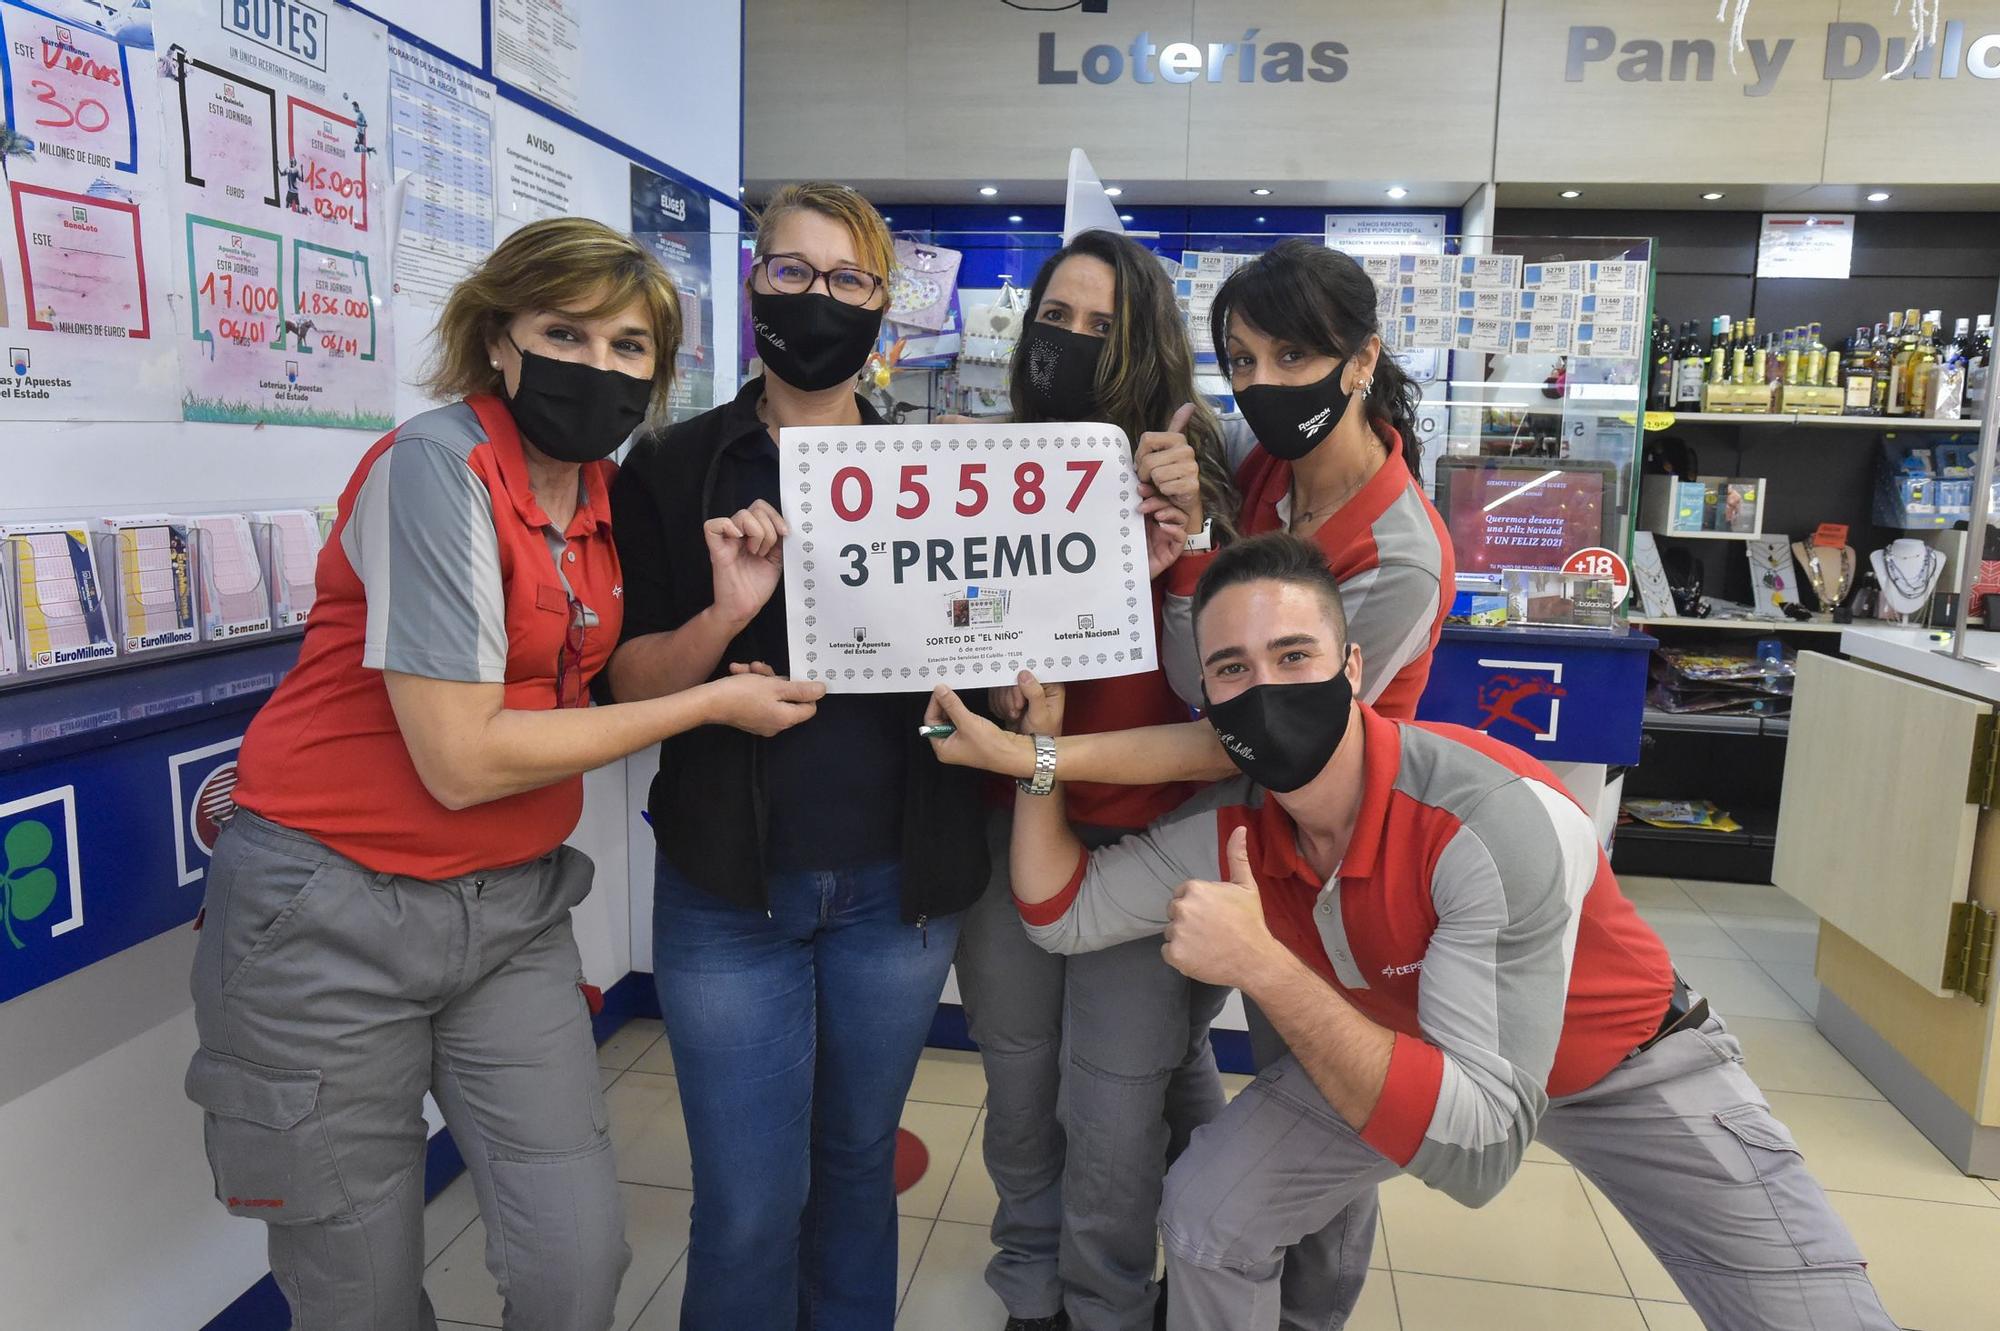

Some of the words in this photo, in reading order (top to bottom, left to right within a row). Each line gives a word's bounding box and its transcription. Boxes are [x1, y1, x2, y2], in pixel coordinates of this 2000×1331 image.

[14, 42, 35, 59] ESTE
[41, 36, 90, 58] EuroMillones
[229, 46, 239, 58] UN
[258, 58, 289, 80] ACERTANTE
[1037, 28, 1349, 85] Loterías
[1564, 25, 1716, 82] Pan
[1744, 38, 1795, 97] y
[31, 80, 110, 132] 30
[208, 103, 224, 116] ESTA
[225, 107, 253, 127] JORNADA
[311, 138, 324, 151] ESTA
[324, 143, 346, 159] JORNADA
[526, 133, 554, 155] AVISO
[39, 142, 74, 161] MILLONES
[76, 149, 86, 162] DE
[87, 152, 111, 169] EUROS
[226, 185, 245, 199] EUROS
[63, 220, 98, 233] BonoLoto
[32, 233, 52, 247] ESTE
[217, 259, 232, 272] ESTA
[233, 262, 259, 277] JORNADA
[199, 272, 279, 314] 17.000
[315, 279, 329, 292] ESTA
[298, 292, 369, 318] 1.856.000
[59, 321, 93, 335] MILLONES
[94, 324, 103, 336] DE
[103, 325, 126, 338] EUROS
[219, 318, 265, 343] 06/01
[15, 378, 21, 388] y
[24, 376, 72, 389] Apuestas
[259, 379, 287, 390] Loterías
[288, 383, 293, 392] y
[293, 383, 323, 394] Apuestas
[14, 388, 50, 399] Estado
[275, 391, 285, 400] del
[286, 392, 309, 402] Estado
[1297, 407, 1331, 432] Reebok
[830, 460, 1104, 522] 05587
[1485, 515, 1527, 524] Queremos
[1528, 515, 1564, 525] desearte
[1504, 525, 1525, 534] Feliz
[1526, 526, 1563, 535] Navidad
[1485, 536, 1493, 545] Y
[1494, 536, 1509, 545] UN
[1510, 537, 1539, 546] FELIZ
[1540, 538, 1563, 547] 2021
[893, 531, 1097, 584] PREMIO
[1574, 556, 1613, 575] +18
[228, 620, 269, 636] Semanal
[1054, 629, 1084, 642] Lotería
[1084, 627, 1120, 639] Nacional
[140, 631, 192, 648] EuroMillones
[926, 635, 961, 646] SORTEO
[963, 634, 976, 643] DE
[54, 645, 114, 664] EuroMillones
